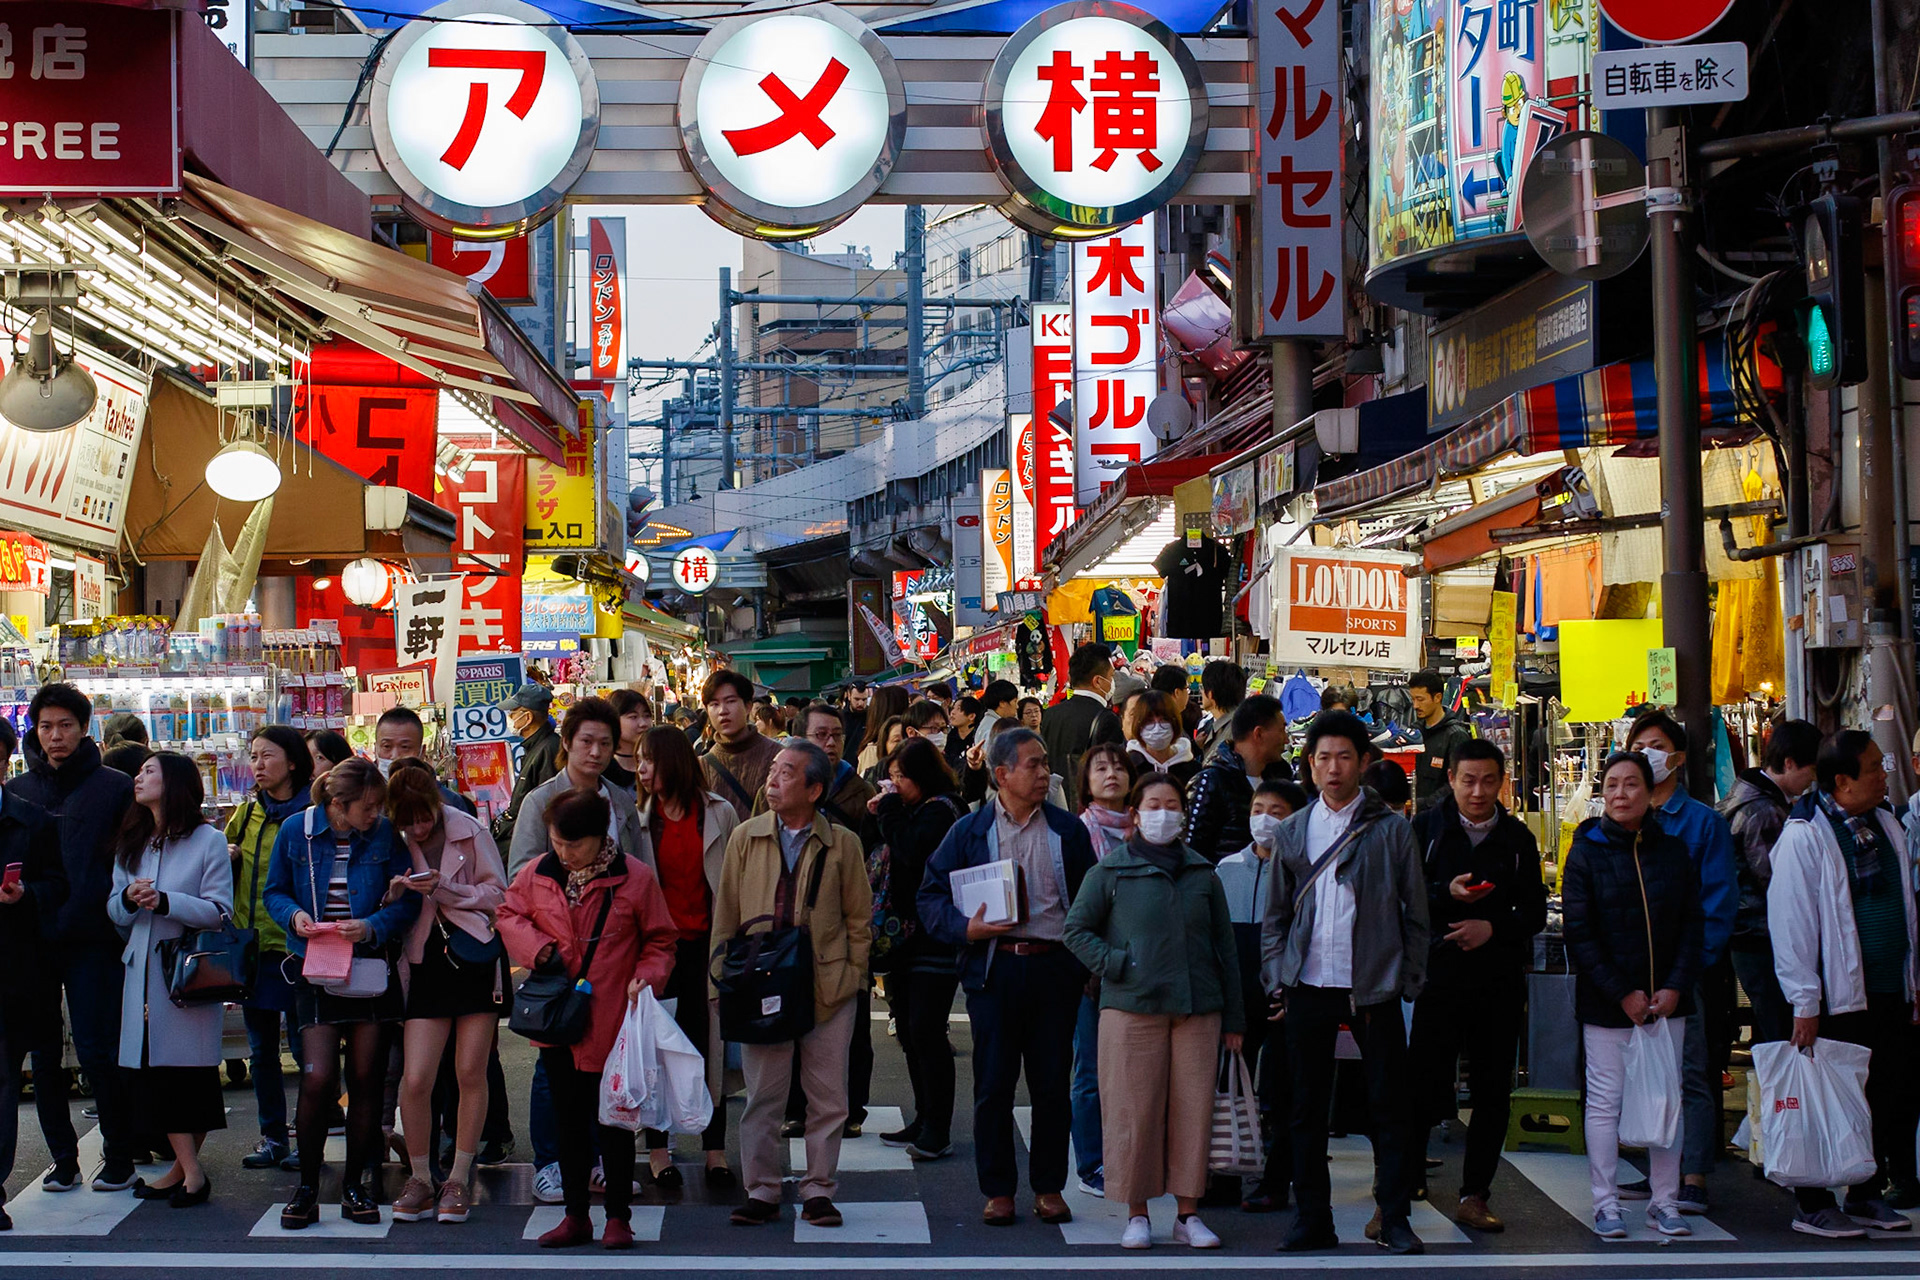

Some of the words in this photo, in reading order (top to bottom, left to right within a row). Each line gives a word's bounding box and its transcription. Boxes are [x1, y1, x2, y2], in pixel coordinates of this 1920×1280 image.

[1605, 57, 1736, 97] 自転車を除く
[1042, 314, 1071, 336] K
[994, 482, 1012, 546] ロンドン
[547, 522, 582, 539] 入口
[1297, 563, 1401, 610] LONDON
[522, 596, 588, 615] elcome
[404, 589, 446, 659] 一軒
[1346, 617, 1397, 632] SPORTS
[1305, 637, 1391, 659] マルセル店
[470, 666, 502, 678] PARIS
